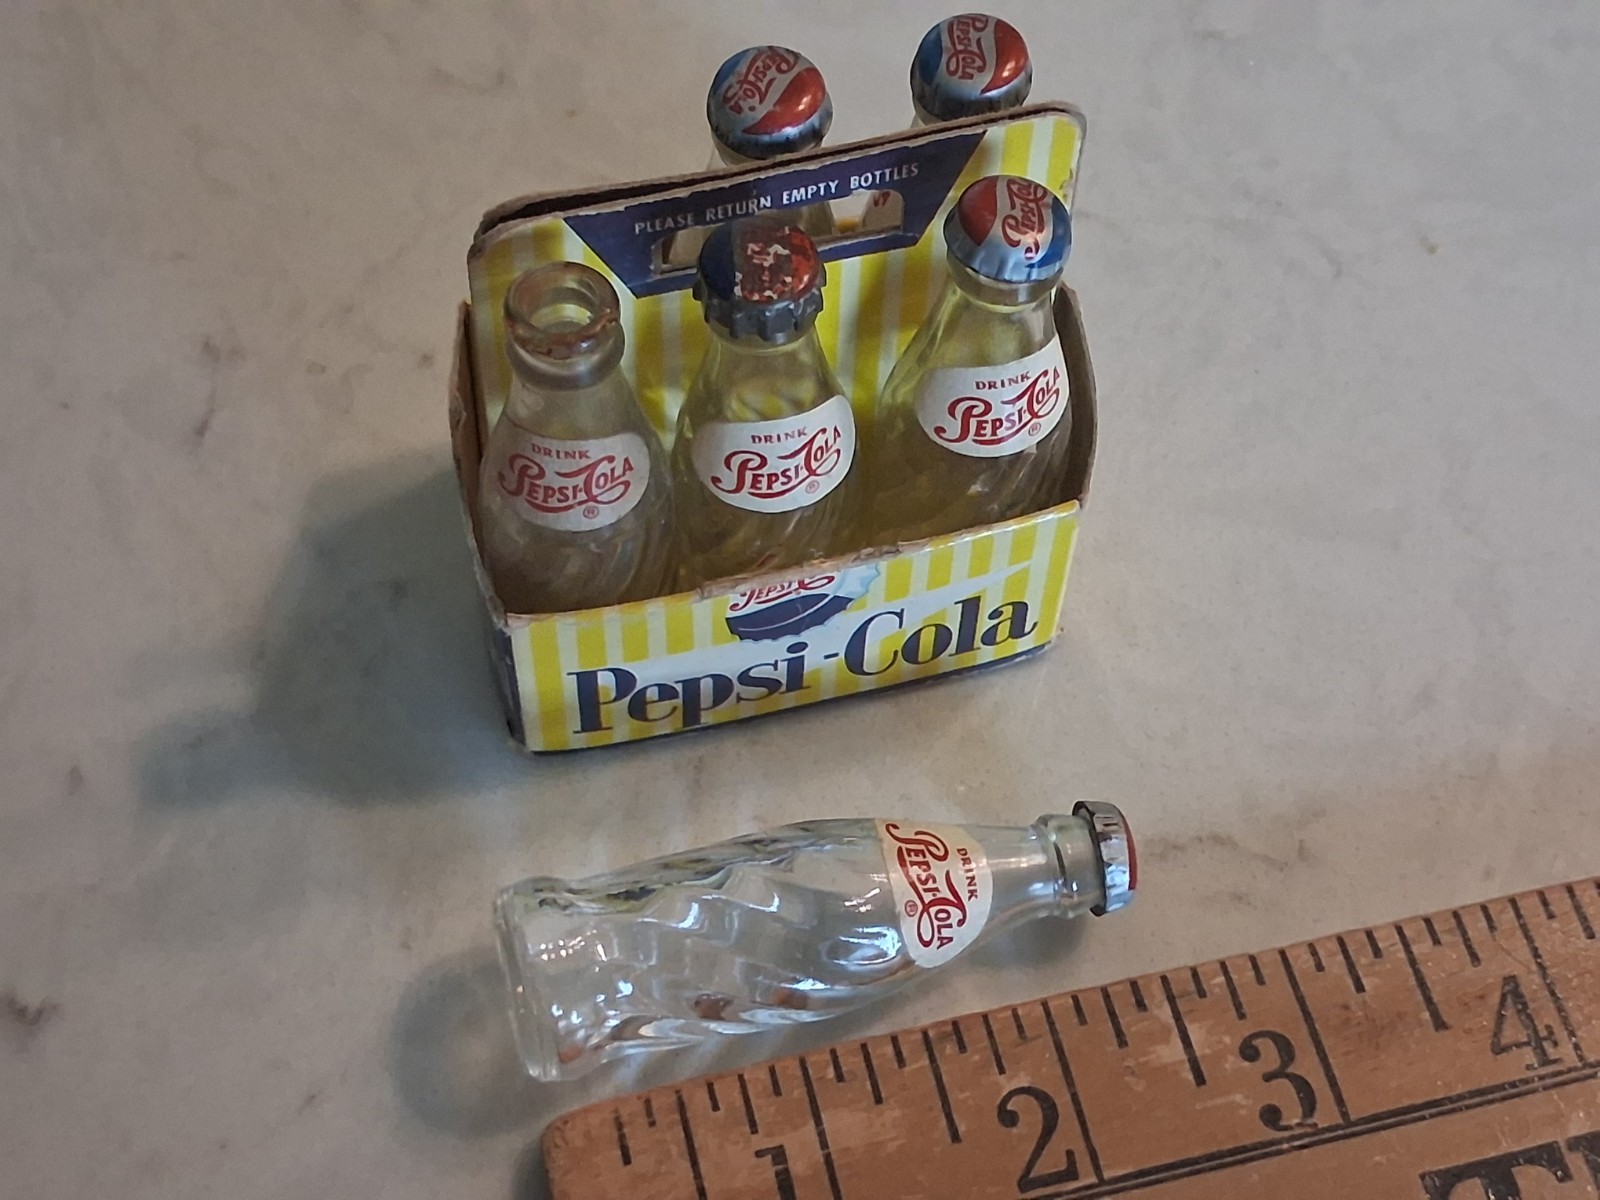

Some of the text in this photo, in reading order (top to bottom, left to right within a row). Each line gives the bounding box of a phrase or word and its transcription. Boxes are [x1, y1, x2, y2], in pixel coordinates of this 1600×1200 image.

[635, 162, 920, 235] PLEASE RETURN EMPTY BOTTLES
[974, 370, 1031, 390] DRINK
[531, 442, 592, 460] DRINK
[750, 426, 807, 444] DRINK
[956, 847, 978, 902] DRINK
[754, 974, 1564, 1200] 1 2 3 4
